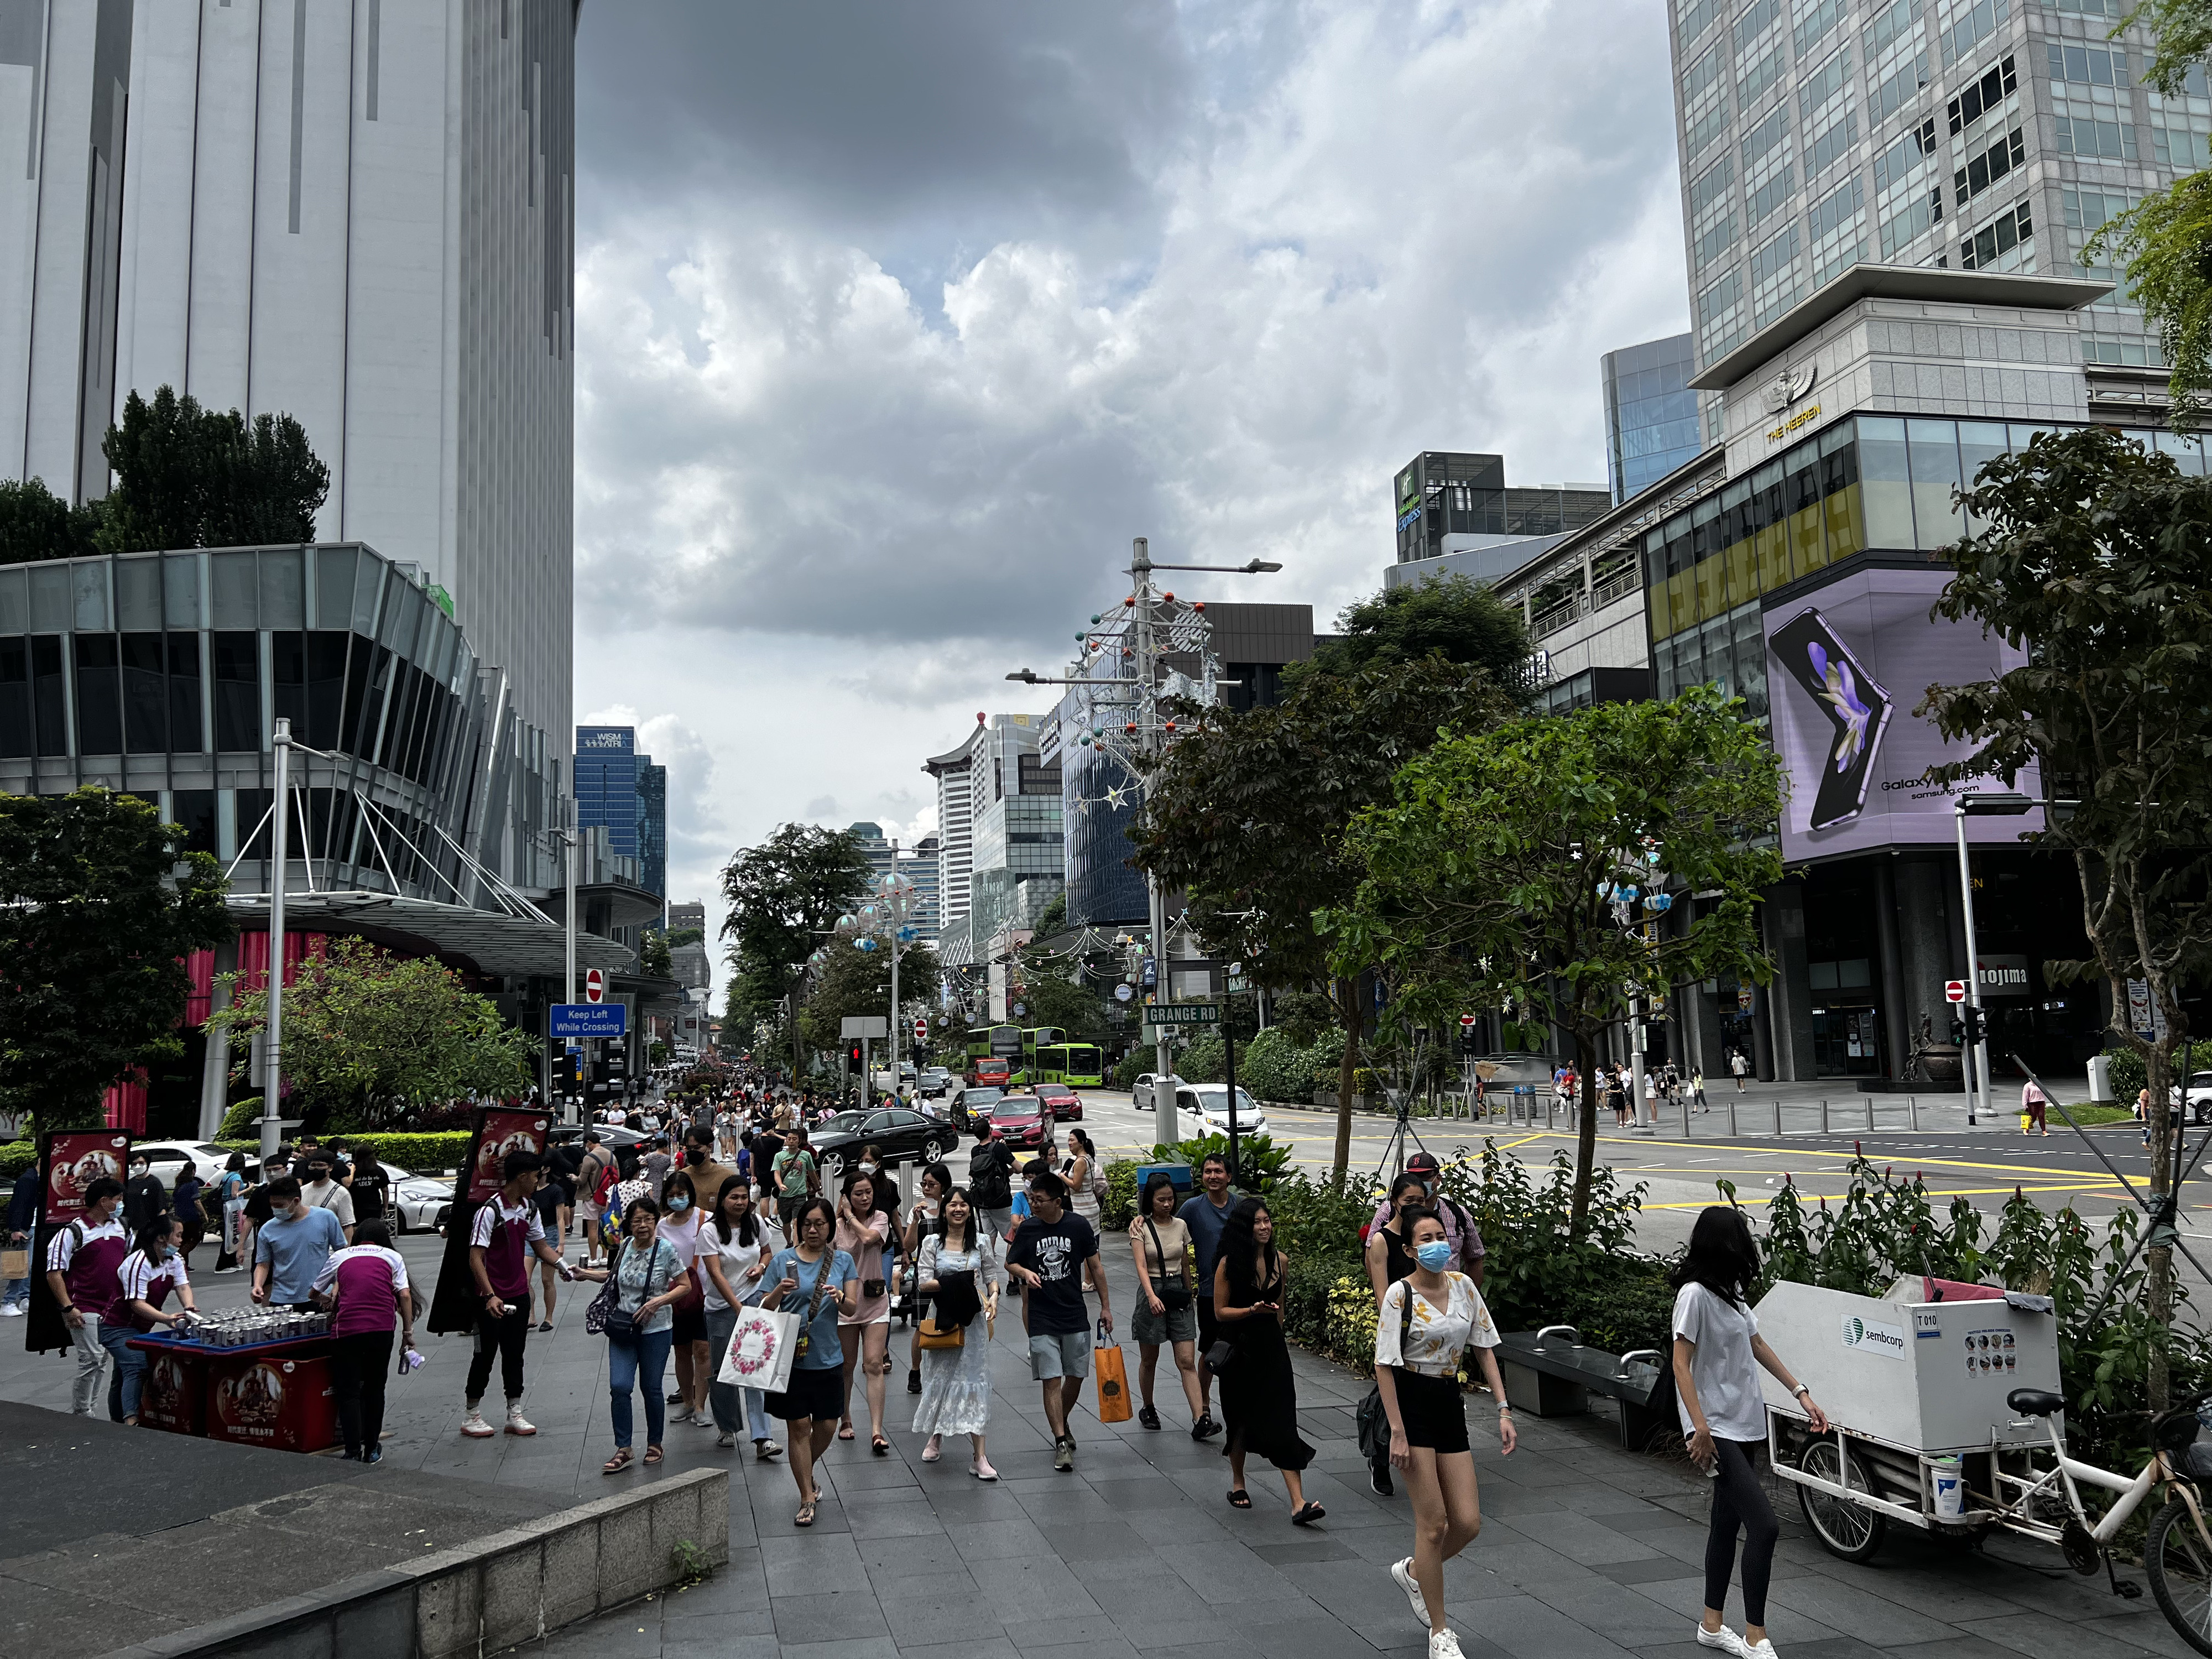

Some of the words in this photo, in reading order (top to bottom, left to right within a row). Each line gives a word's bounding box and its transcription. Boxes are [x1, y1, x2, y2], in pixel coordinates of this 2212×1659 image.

[1766, 426, 1783, 445] THE
[1784, 403, 1822, 434] HEEREN
[1398, 500, 1413, 517] Holiday
[1398, 505, 1421, 533] Express
[1881, 777, 1933, 791] Galaxy
[1911, 785, 1980, 800] samsung.com
[568, 1010, 589, 1020] Keep
[591, 1010, 608, 1019] Left
[1150, 1007, 1197, 1022] GRANGE
[1201, 1006, 1216, 1020] RD
[556, 1022, 580, 1031] While
[582, 1022, 619, 1032] Crossing
[1036, 1236, 1071, 1256] ADIDAS
[1917, 1316, 1923, 1326] T
[1924, 1315, 1937, 1326] 010
[1866, 1331, 1903, 1350] sembcorp
